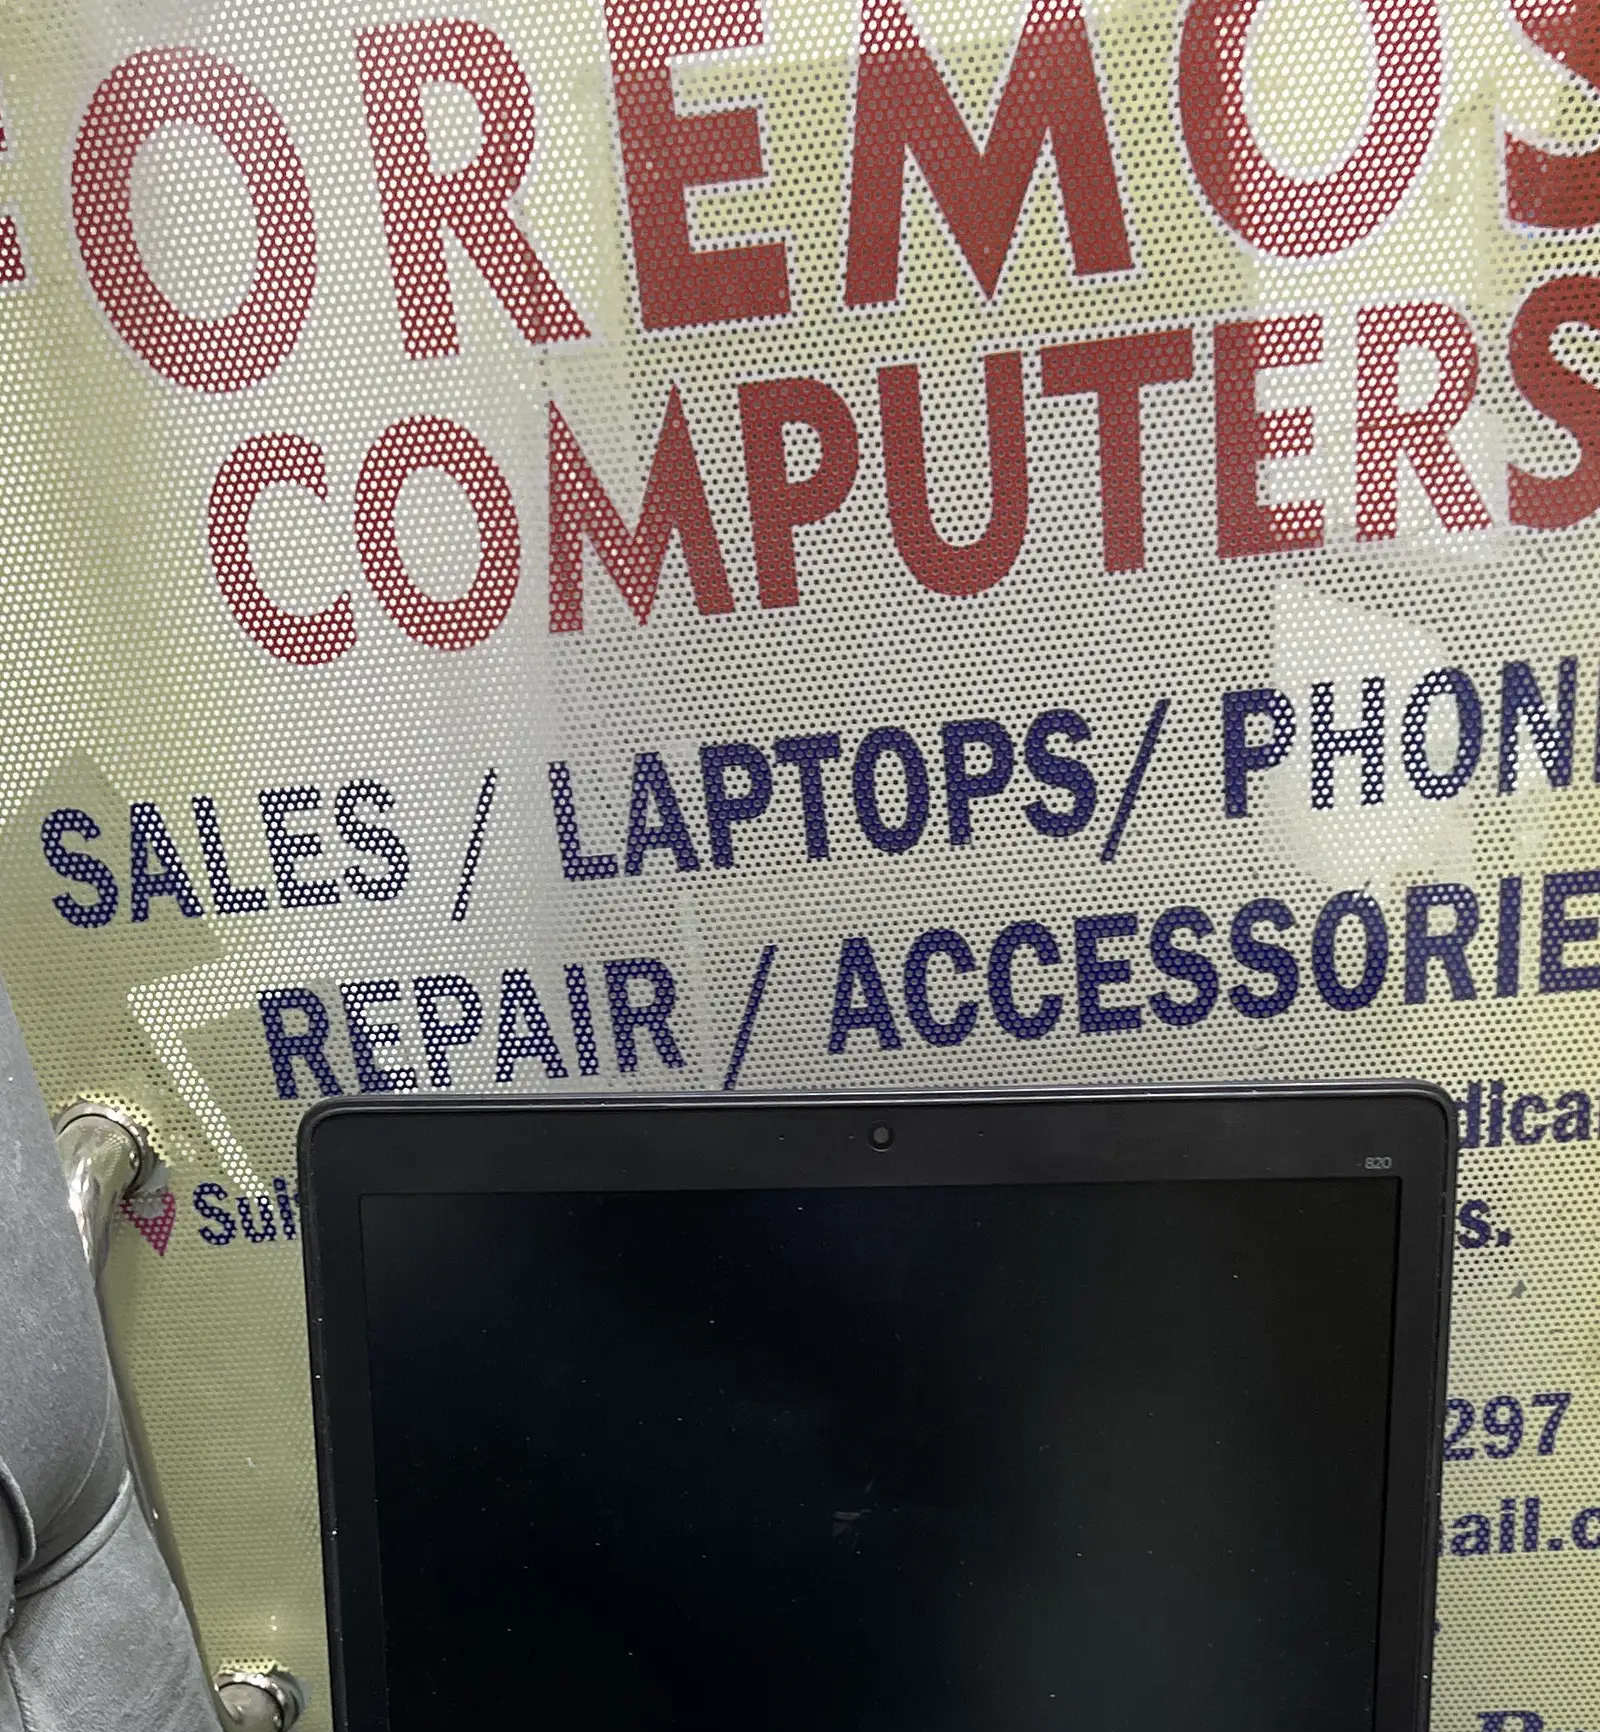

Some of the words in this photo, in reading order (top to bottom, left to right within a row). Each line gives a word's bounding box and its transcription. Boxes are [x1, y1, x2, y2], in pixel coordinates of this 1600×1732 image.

[207, 274, 1600, 666] COMPUTERS
[41, 777, 411, 929] SALES
[1219, 655, 1600, 821] PHON
[256, 957, 687, 1100] REPAIR
[193, 1176, 300, 1246] Sui
[1364, 1156, 1393, 1170] 820
